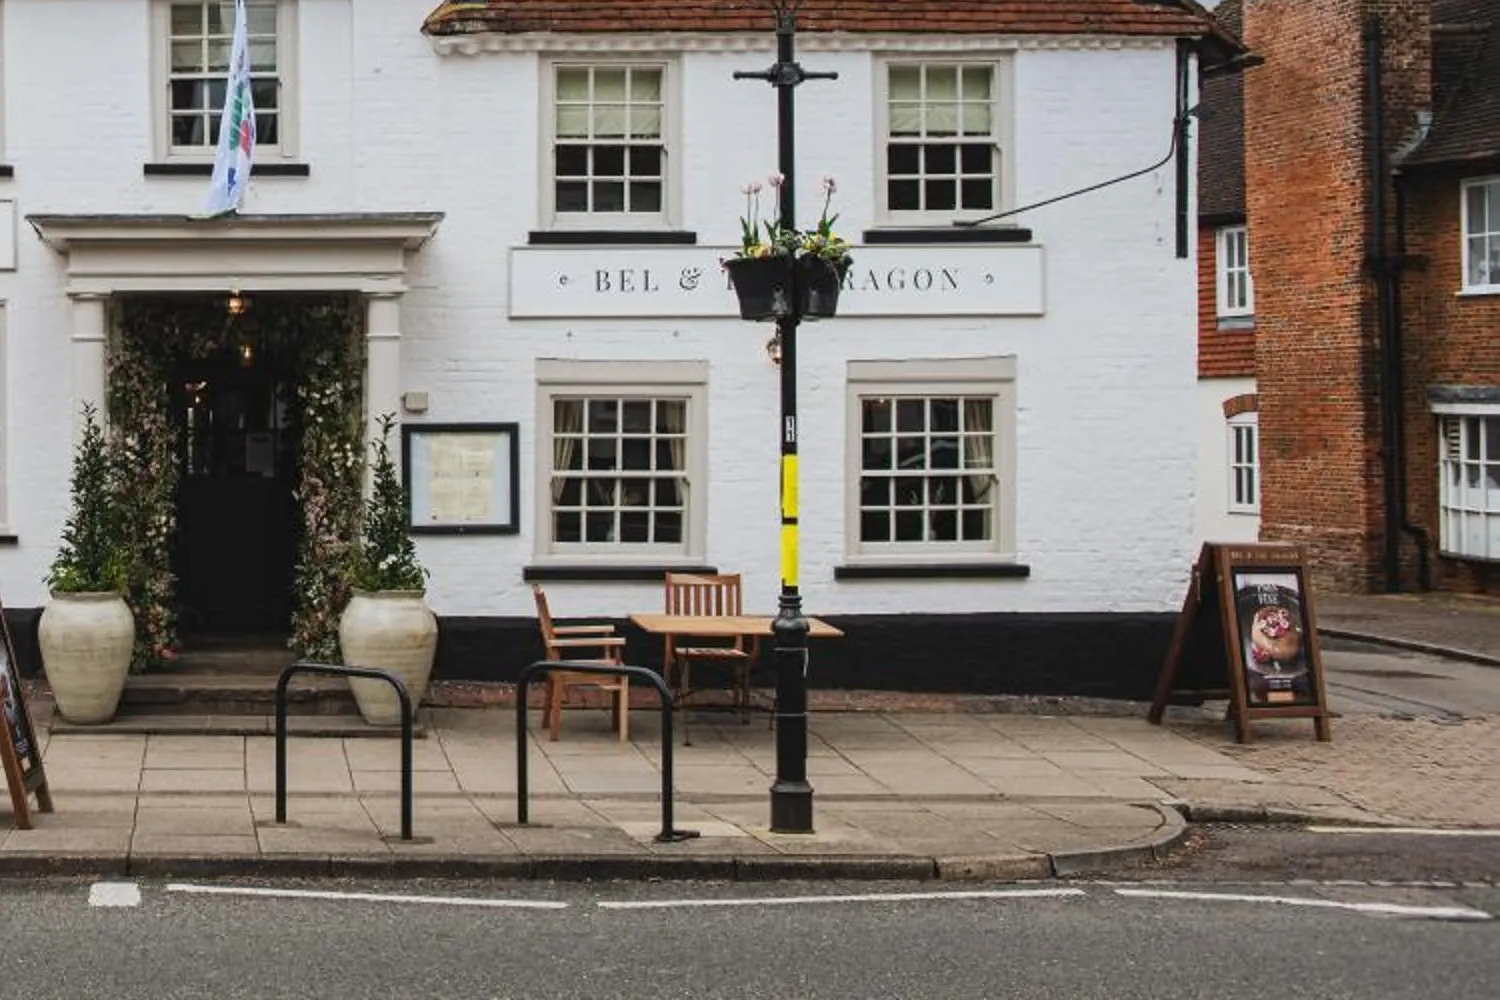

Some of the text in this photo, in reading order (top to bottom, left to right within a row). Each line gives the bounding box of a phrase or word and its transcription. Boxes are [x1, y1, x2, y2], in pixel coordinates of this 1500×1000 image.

[595, 269, 659, 292] BEL
[679, 267, 702, 291] &
[840, 268, 960, 291] RAGON
